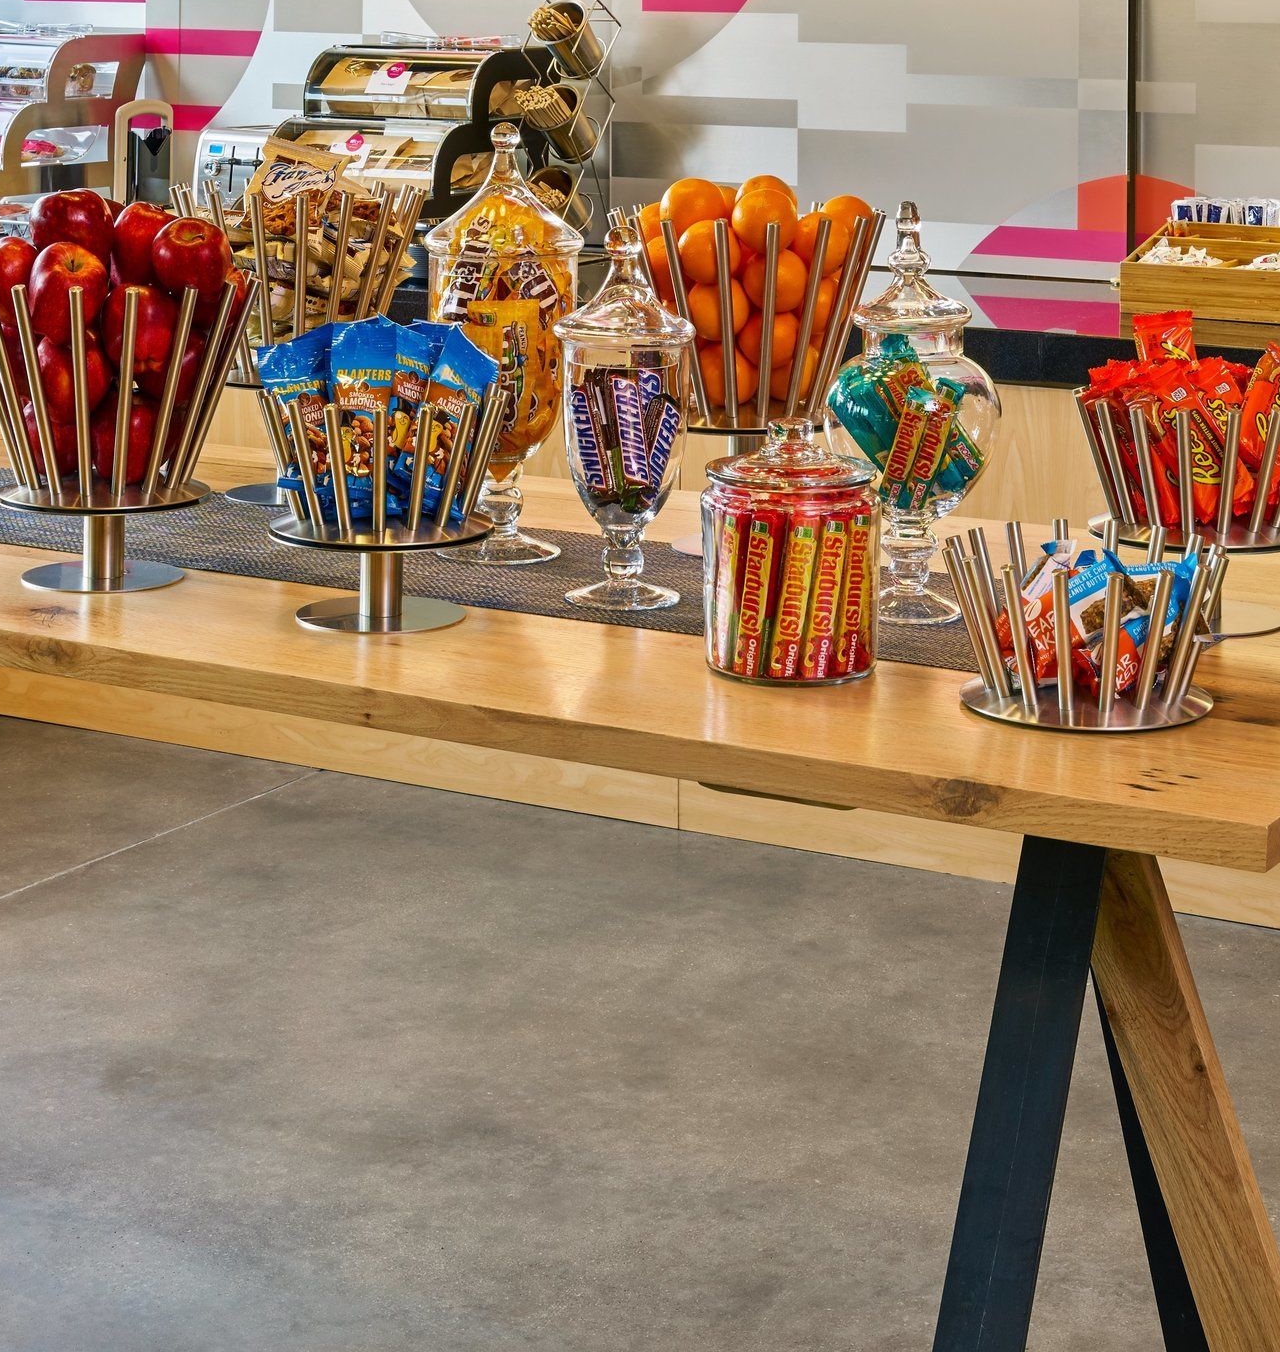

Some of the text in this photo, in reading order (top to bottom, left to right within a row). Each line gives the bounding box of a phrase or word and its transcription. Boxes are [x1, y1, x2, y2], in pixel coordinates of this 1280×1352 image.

[336, 368, 392, 382] PLANTERS
[339, 397, 383, 410] ALMONDS
[570, 391, 606, 488] SNICKERS
[613, 378, 649, 483] SNICKERS
[887, 411, 922, 482] Starburst
[741, 535, 769, 637] Starburst
[779, 541, 813, 641] Starburst
[812, 536, 844, 637] Starburst
[845, 529, 869, 630] Starburst
